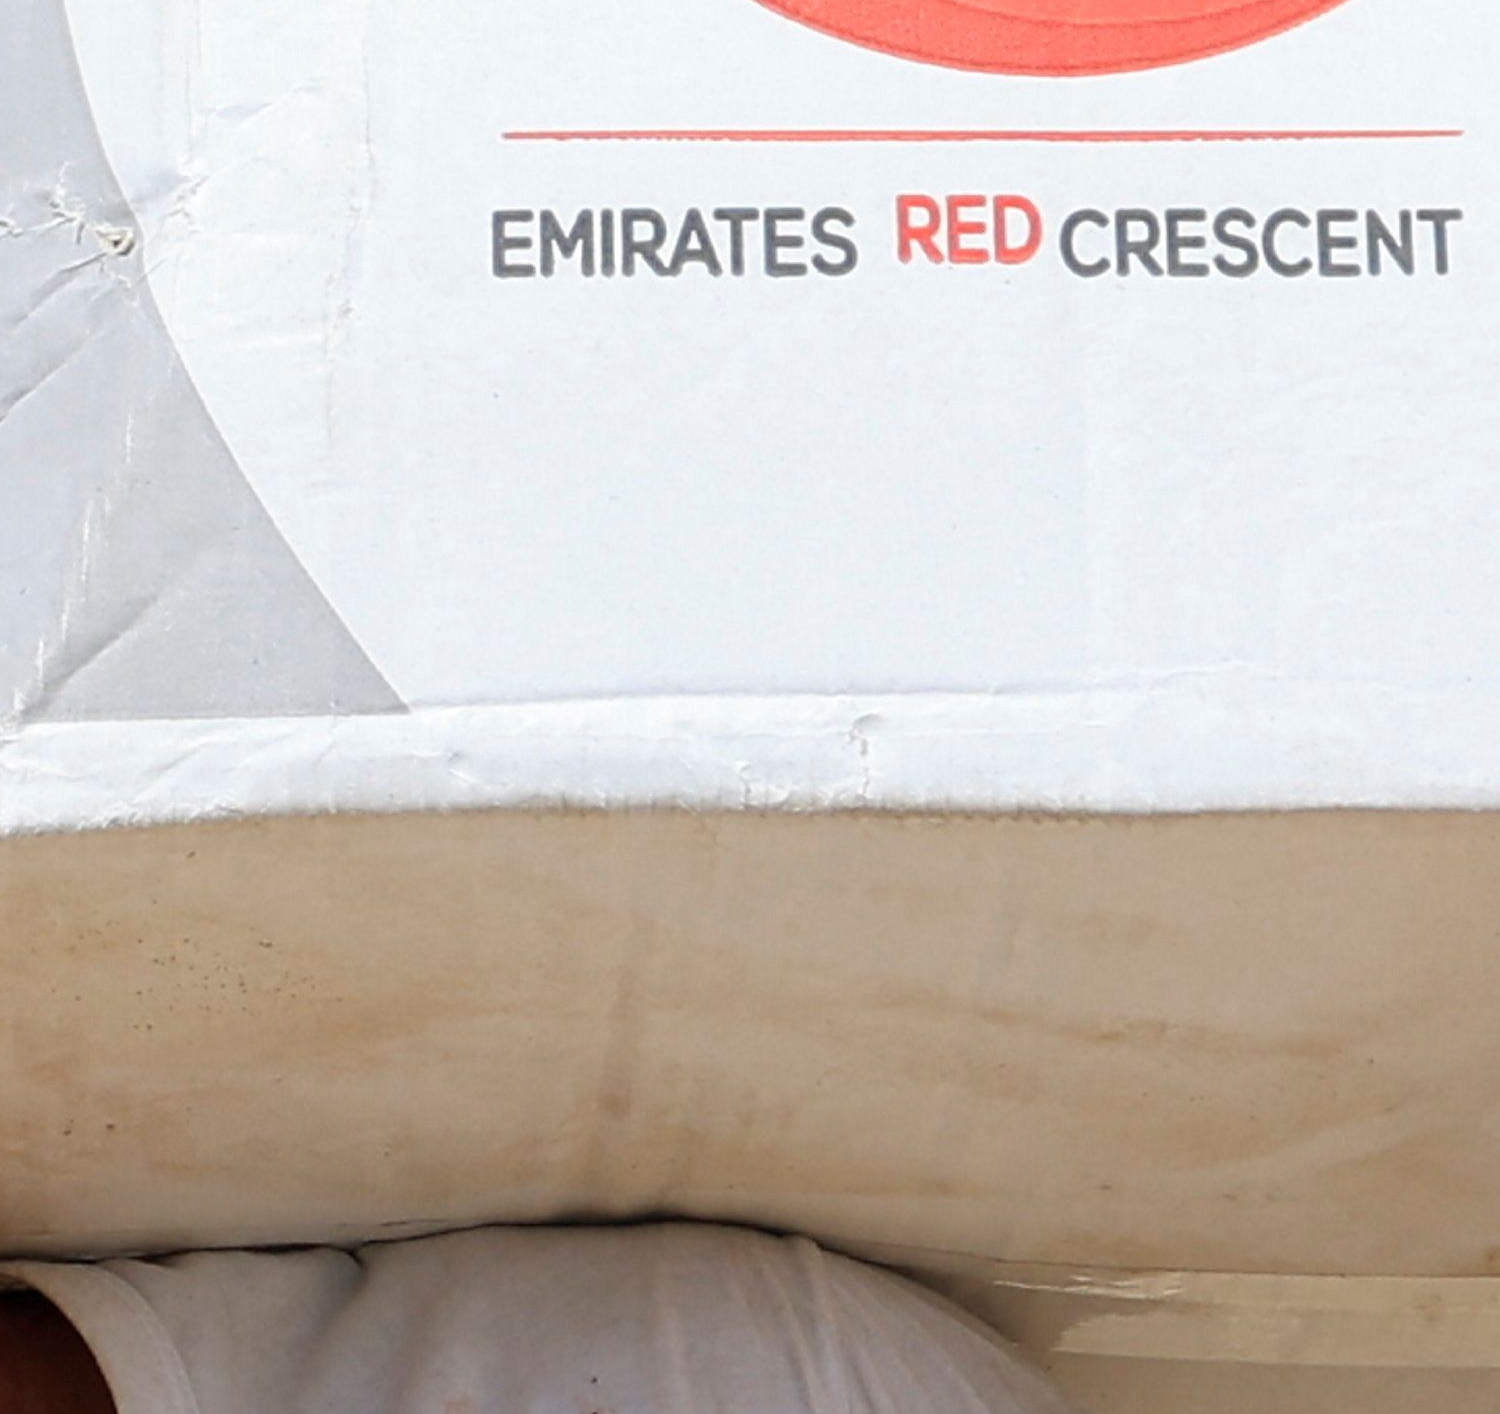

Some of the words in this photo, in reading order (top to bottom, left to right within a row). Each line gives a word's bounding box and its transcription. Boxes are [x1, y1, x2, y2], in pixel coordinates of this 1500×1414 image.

[491, 207, 858, 278] EMIRATES
[896, 194, 1043, 265] RED
[1059, 207, 1463, 278] CRESCENT
